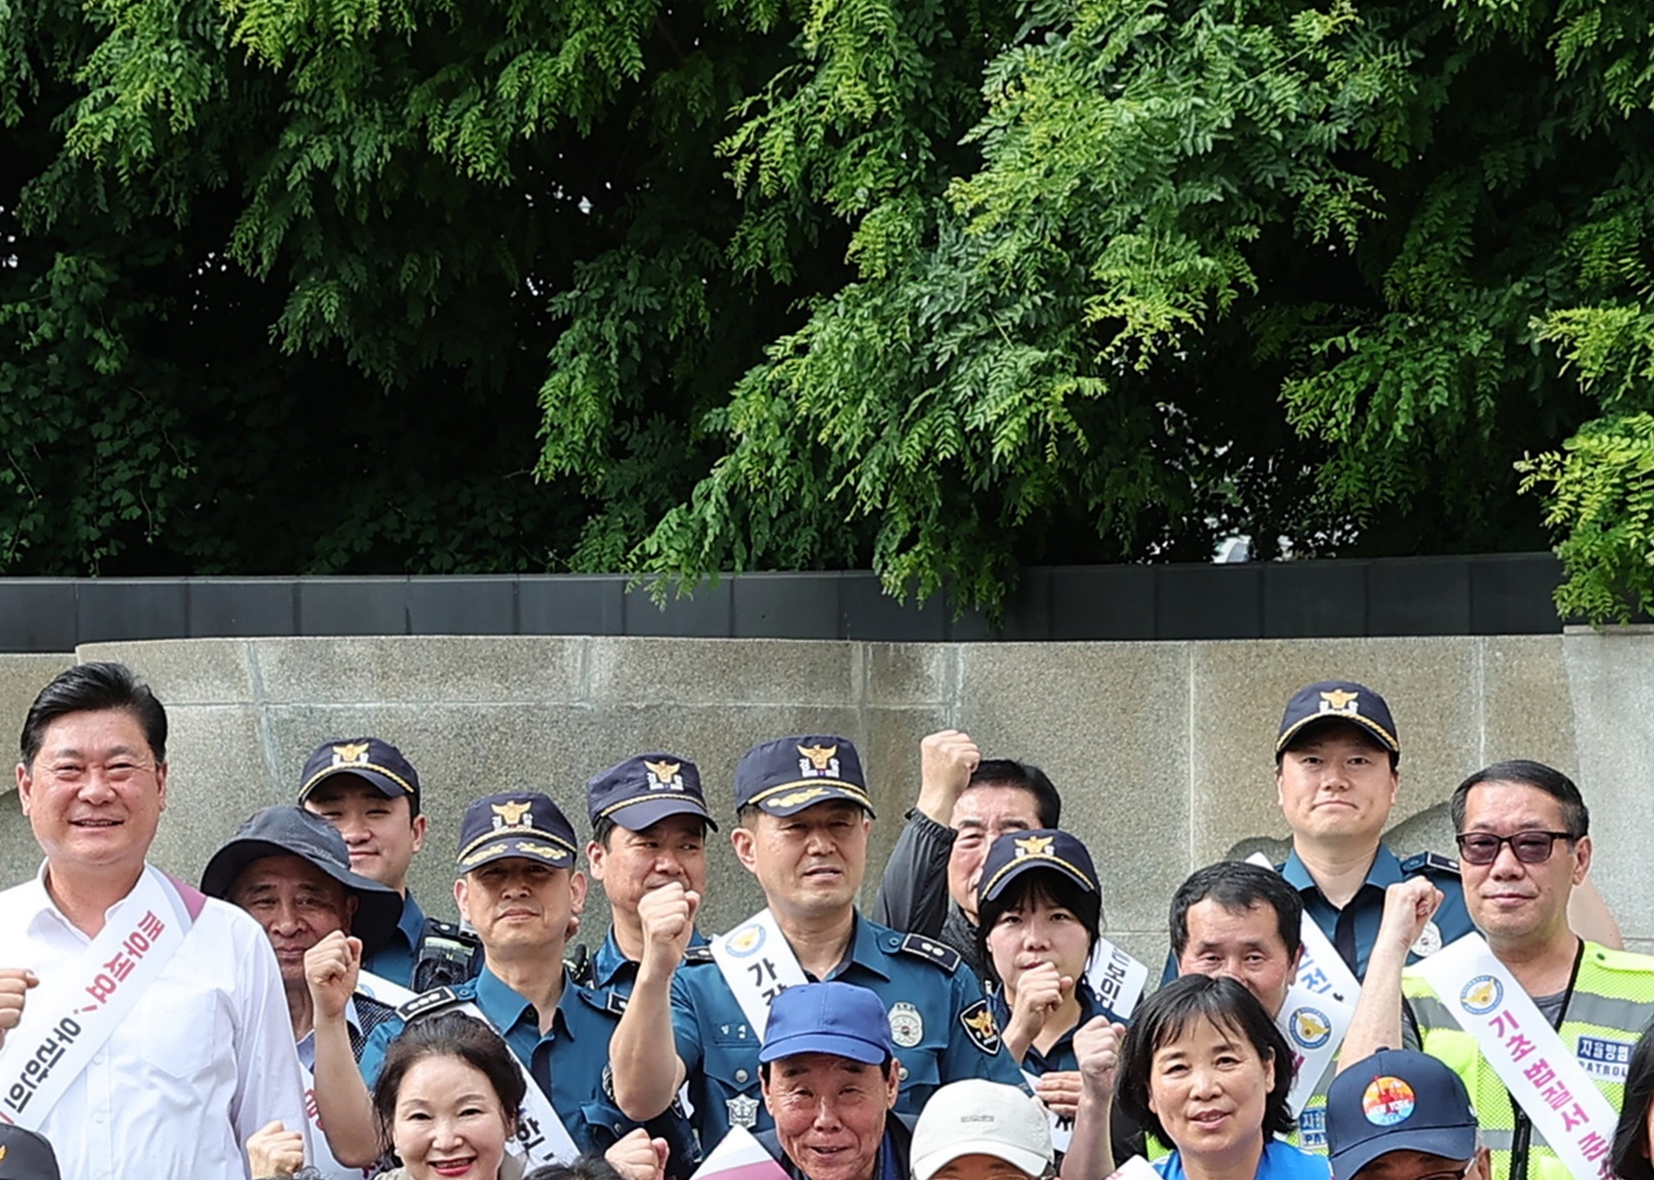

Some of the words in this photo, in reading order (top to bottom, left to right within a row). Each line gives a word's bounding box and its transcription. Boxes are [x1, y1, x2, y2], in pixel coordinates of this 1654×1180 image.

[73, 910, 165, 1016] 깨우세요!
[1488, 1013, 1536, 1063] 기초
[1523, 1064, 1589, 1132] 법질서
